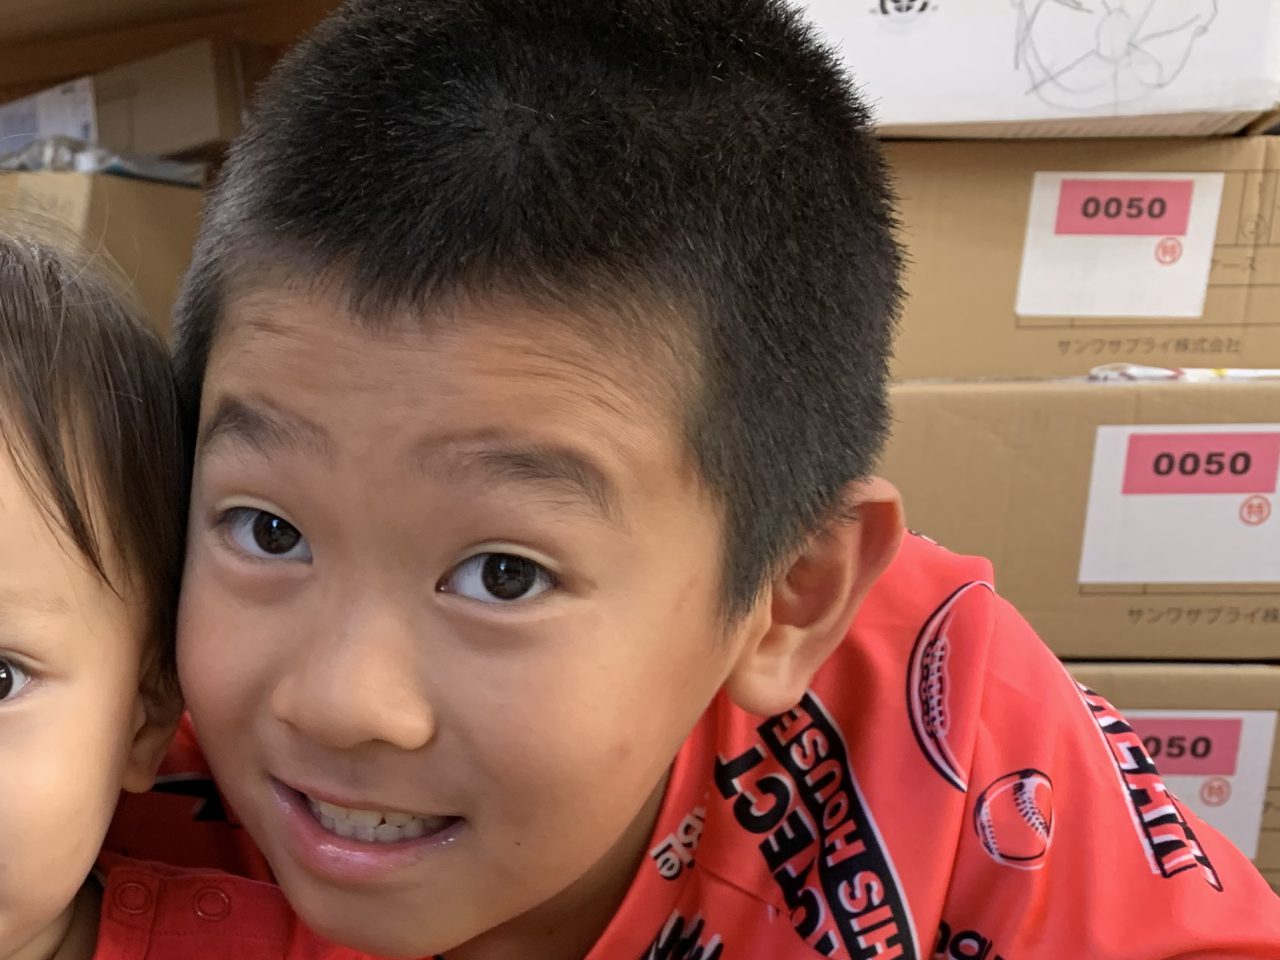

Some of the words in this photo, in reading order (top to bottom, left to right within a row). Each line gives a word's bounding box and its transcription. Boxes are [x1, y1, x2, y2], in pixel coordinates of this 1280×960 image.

[1081, 197, 1167, 219] 0050
[1153, 451, 1252, 476] 0050
[772, 709, 868, 868] HOUSE
